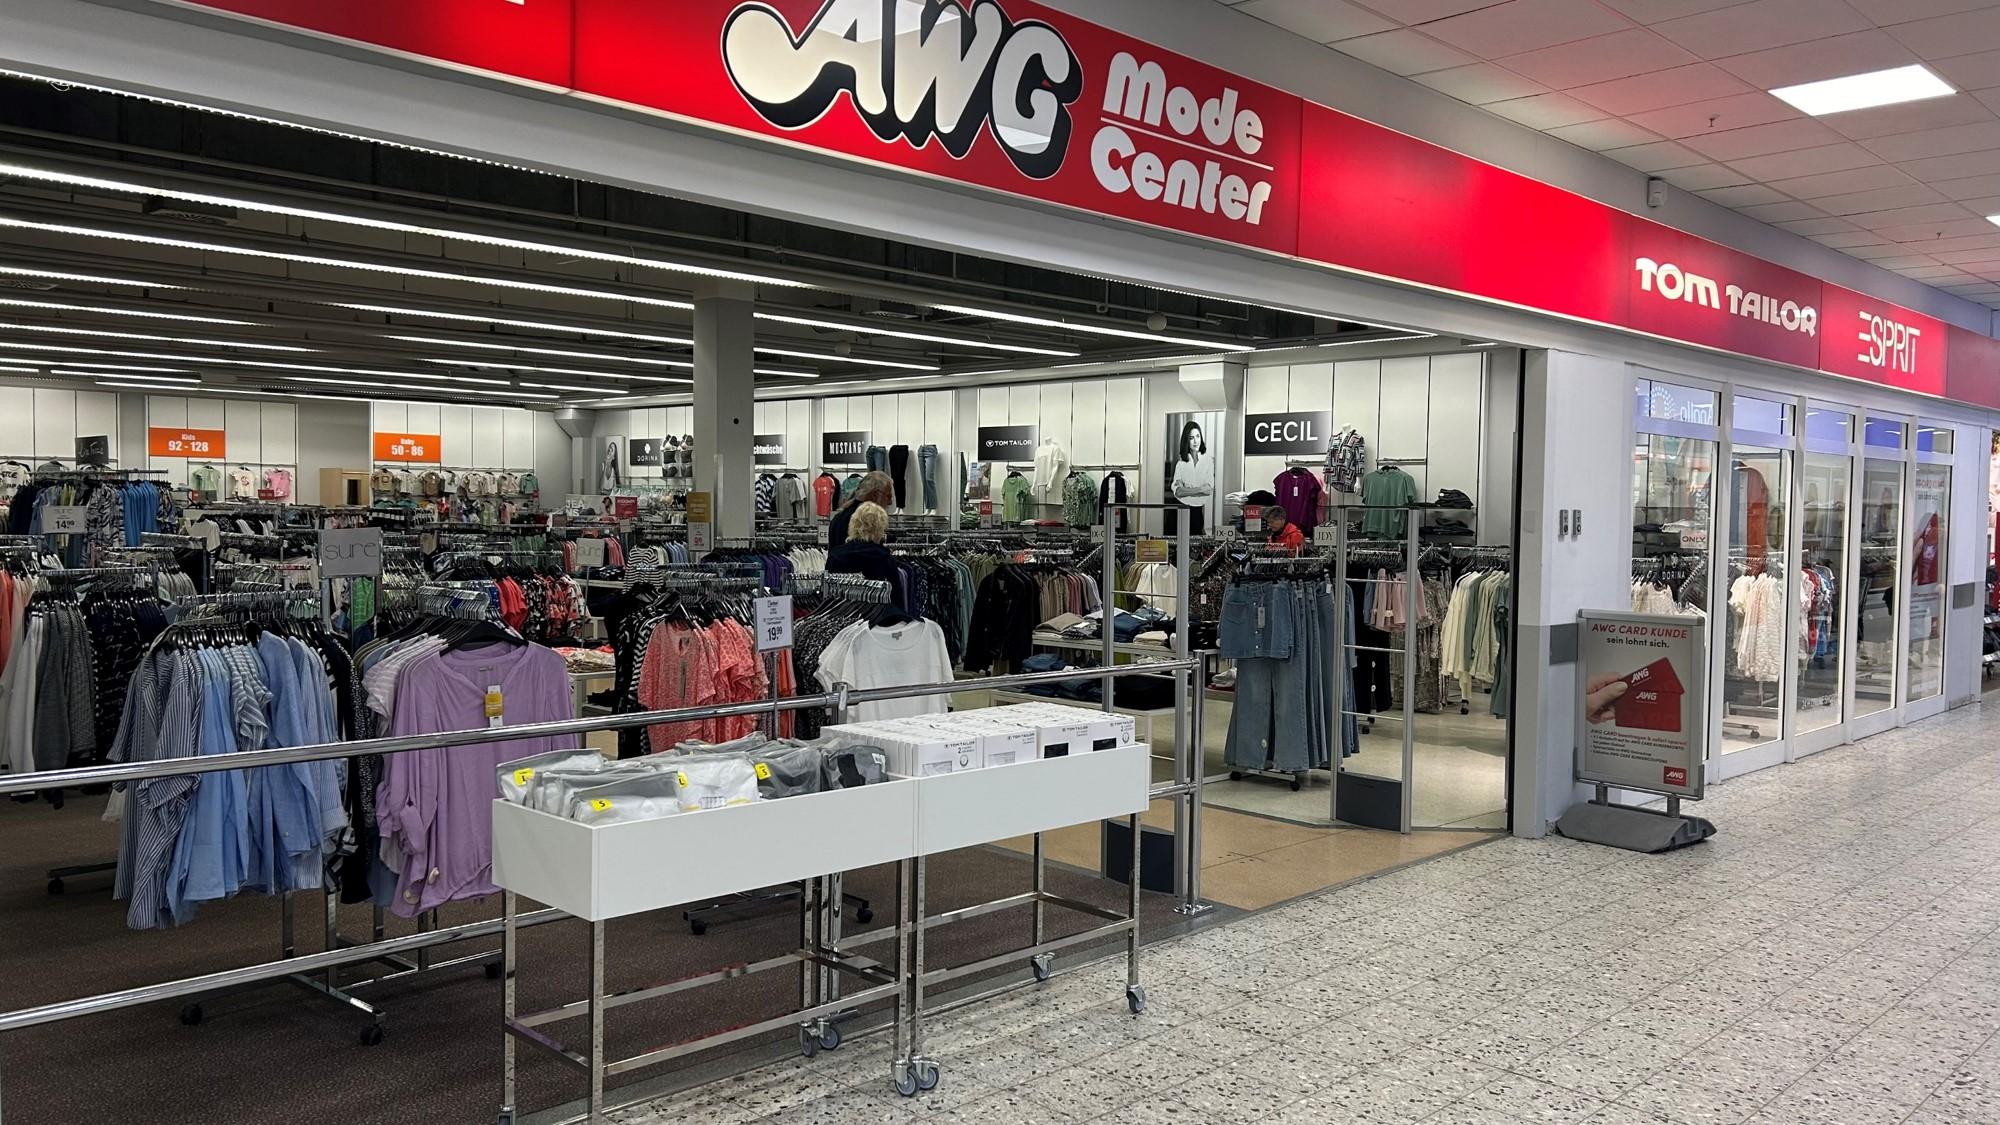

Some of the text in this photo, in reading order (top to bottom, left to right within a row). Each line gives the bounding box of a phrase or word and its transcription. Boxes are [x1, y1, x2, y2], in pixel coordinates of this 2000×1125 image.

[723, 0, 1076, 165] AWG
[1102, 52, 1264, 155] Mode
[1090, 126, 1272, 225] Center
[1635, 257, 1817, 337] TOM TAILOR
[1857, 310, 1921, 374] ESPRIT
[1254, 421, 1318, 442] CECIL
[168, 441, 183, 451] 92
[191, 442, 209, 452] 128
[391, 445, 404, 455] 50
[411, 446, 424, 456] 86
[1681, 535, 1706, 543] ONLY
[325, 542, 377, 560] sure
[1662, 571, 1685, 580] DORINA
[1592, 623, 1688, 639] AWG CARD KUNDE
[1606, 636, 1670, 648] sein lohnt sich.
[1631, 668, 1649, 683] AWG
[1636, 691, 1657, 701] AWG
[762, 767, 768, 776] S
[1666, 771, 1684, 779] AWG
[598, 800, 606, 808] S
